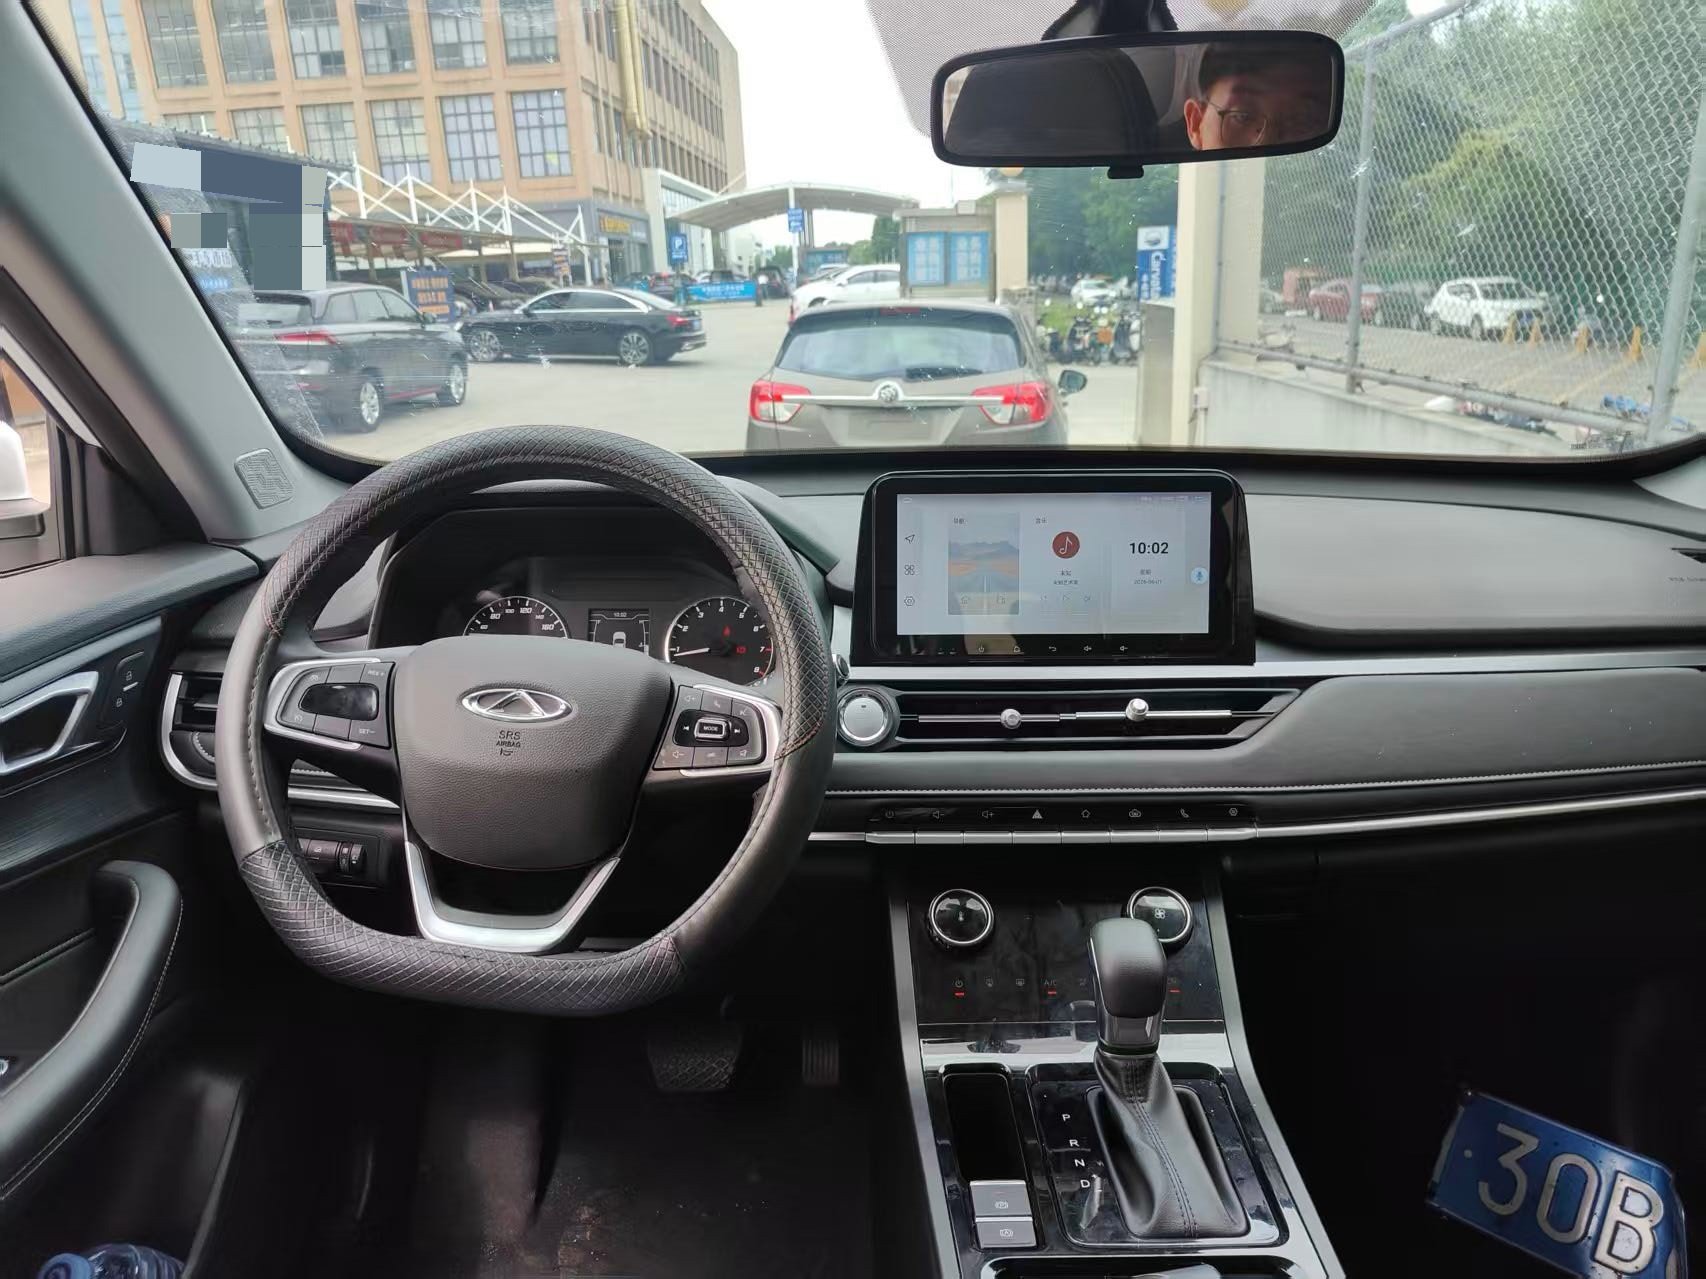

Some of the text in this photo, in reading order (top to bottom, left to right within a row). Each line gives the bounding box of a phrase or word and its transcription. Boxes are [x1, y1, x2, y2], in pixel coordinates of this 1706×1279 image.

[1129, 541, 1169, 555] 10:02
[541, 623, 555, 631] 160
[498, 729, 521, 741] SRS
[495, 740, 522, 748] AIRBAG
[1061, 1113, 1071, 1122] P
[1069, 1138, 1080, 1148] R
[1074, 1158, 1086, 1168] N
[1080, 1179, 1091, 1189] D
[1478, 1122, 1677, 1279] 30B
